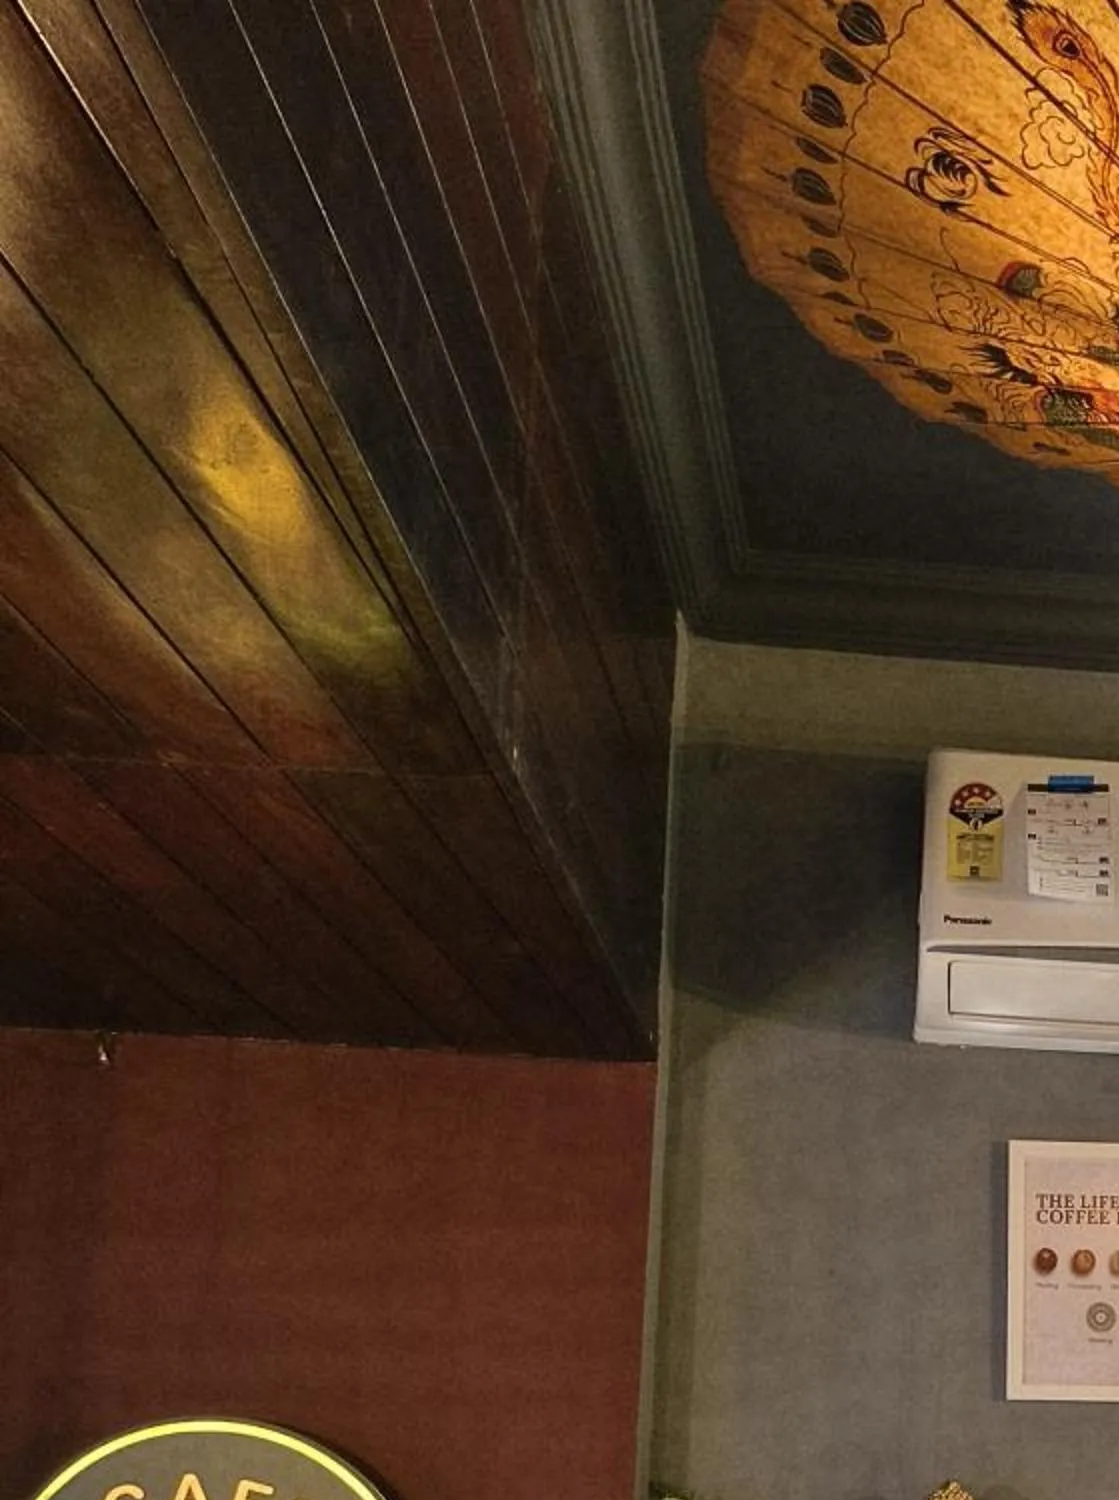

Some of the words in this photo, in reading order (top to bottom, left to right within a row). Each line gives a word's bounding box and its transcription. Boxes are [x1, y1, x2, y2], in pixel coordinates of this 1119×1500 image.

[1035, 1193, 1074, 1209] THE
[1080, 1194, 1119, 1210] LIFE
[1035, 1209, 1111, 1225] COFFEE
